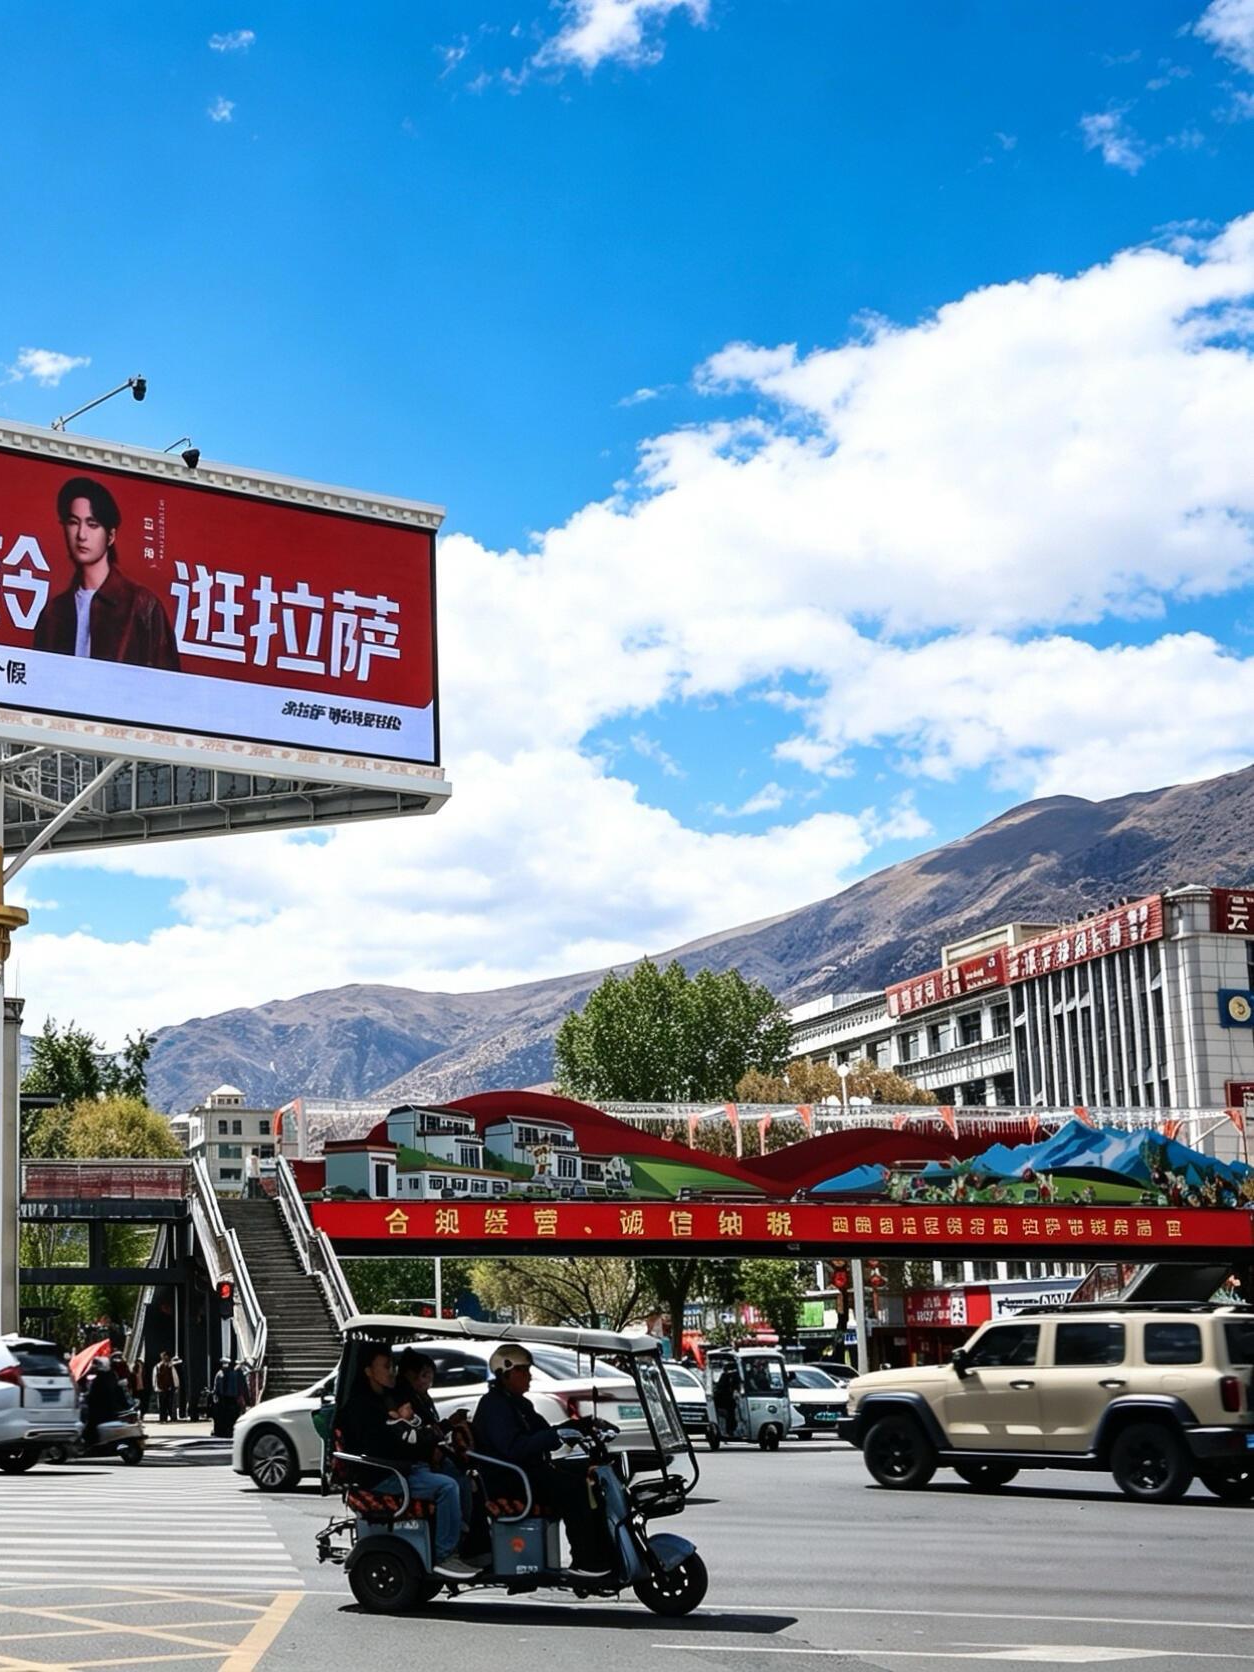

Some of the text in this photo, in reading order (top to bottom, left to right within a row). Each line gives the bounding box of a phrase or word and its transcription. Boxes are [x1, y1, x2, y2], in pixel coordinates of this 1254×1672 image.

[170, 560, 401, 682] 逛拉萨
[384, 1207, 794, 1237] 合规经营、诚信纳税
